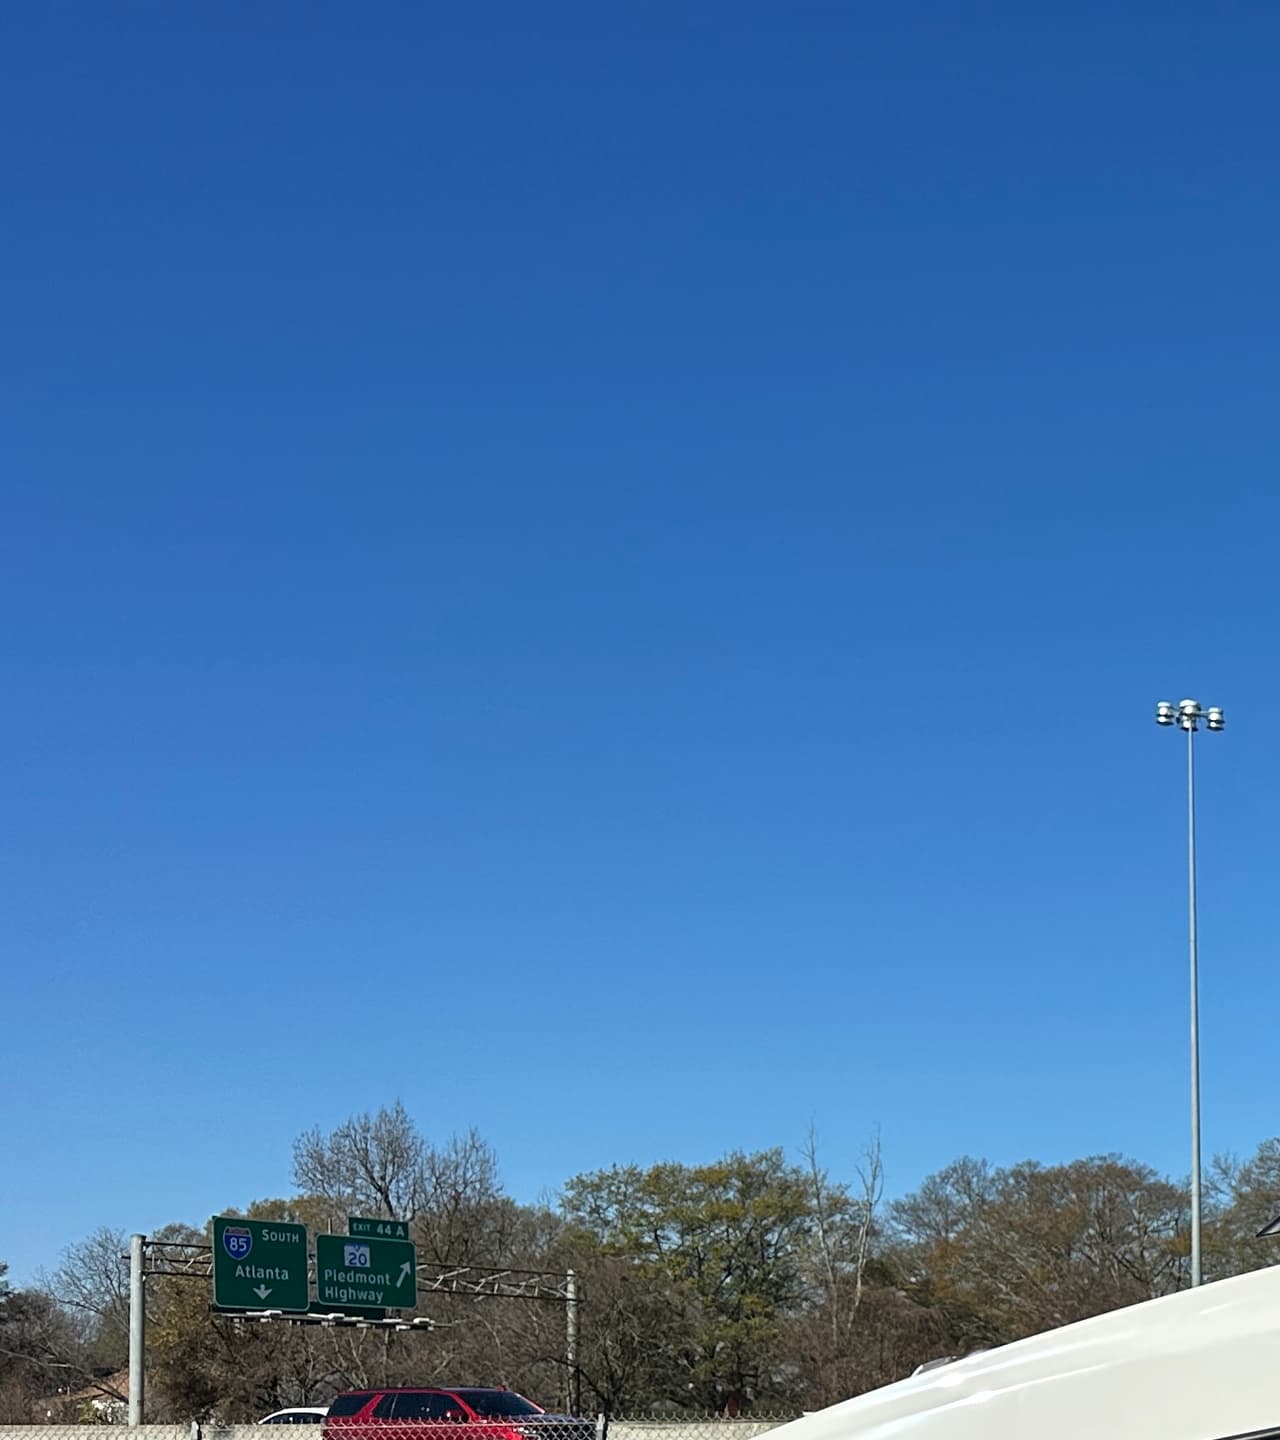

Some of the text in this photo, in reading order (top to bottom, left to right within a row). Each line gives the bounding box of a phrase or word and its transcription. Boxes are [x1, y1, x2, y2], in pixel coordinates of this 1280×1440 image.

[262, 1229, 300, 1243] SOUTH
[353, 1223, 405, 1238] EXIT 44 A
[230, 1236, 247, 1252] 85
[348, 1252, 368, 1266] 20
[235, 1264, 290, 1281] Atlanta
[324, 1269, 391, 1286] Piedmont
[325, 1286, 384, 1305] Highway
